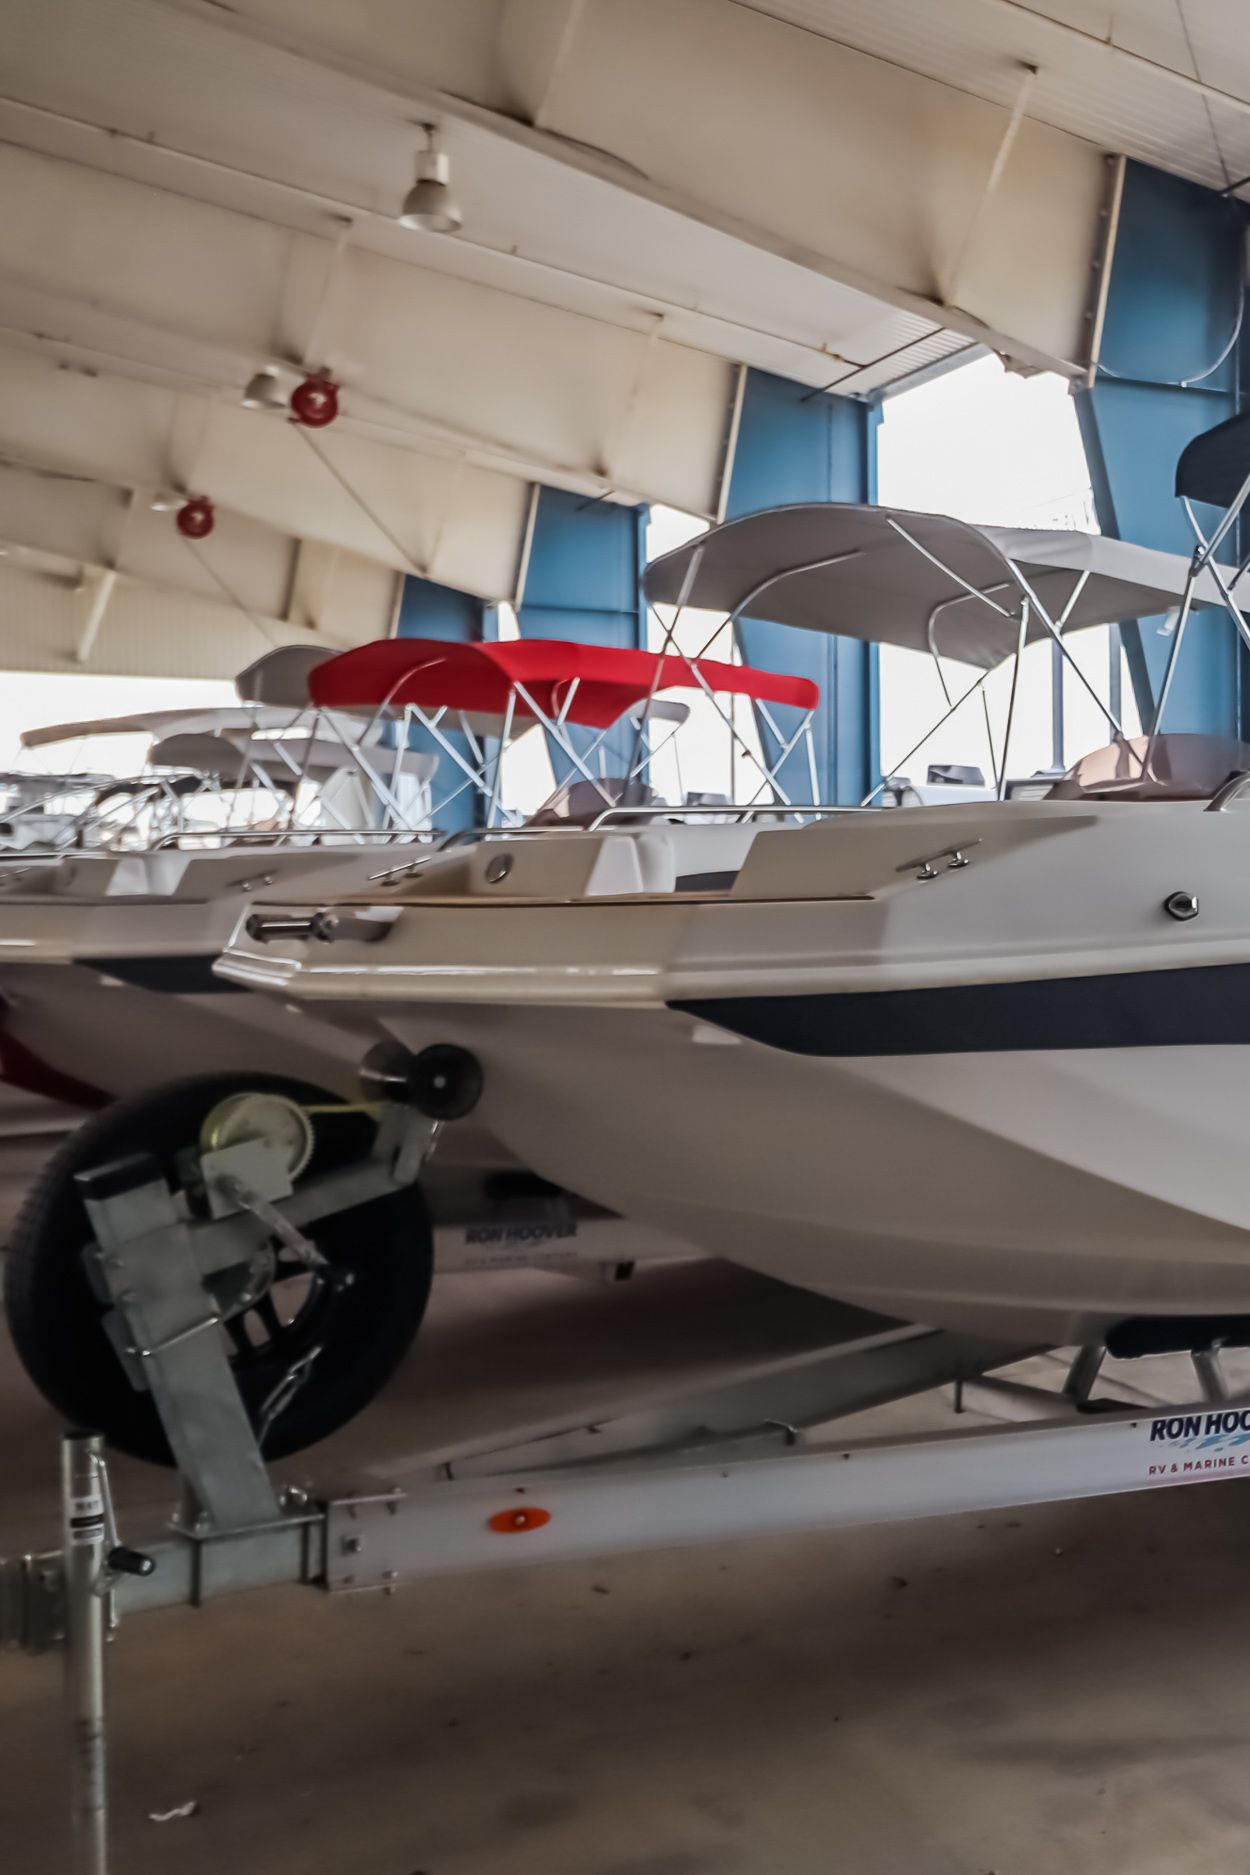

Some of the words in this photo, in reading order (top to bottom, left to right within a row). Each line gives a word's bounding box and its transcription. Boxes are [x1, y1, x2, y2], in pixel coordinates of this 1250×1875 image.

[1150, 1415, 1201, 1441] RON
[1149, 1465, 1167, 1475] RV
[1170, 1463, 1178, 1473] &
[1183, 1456, 1235, 1472] MARINE
